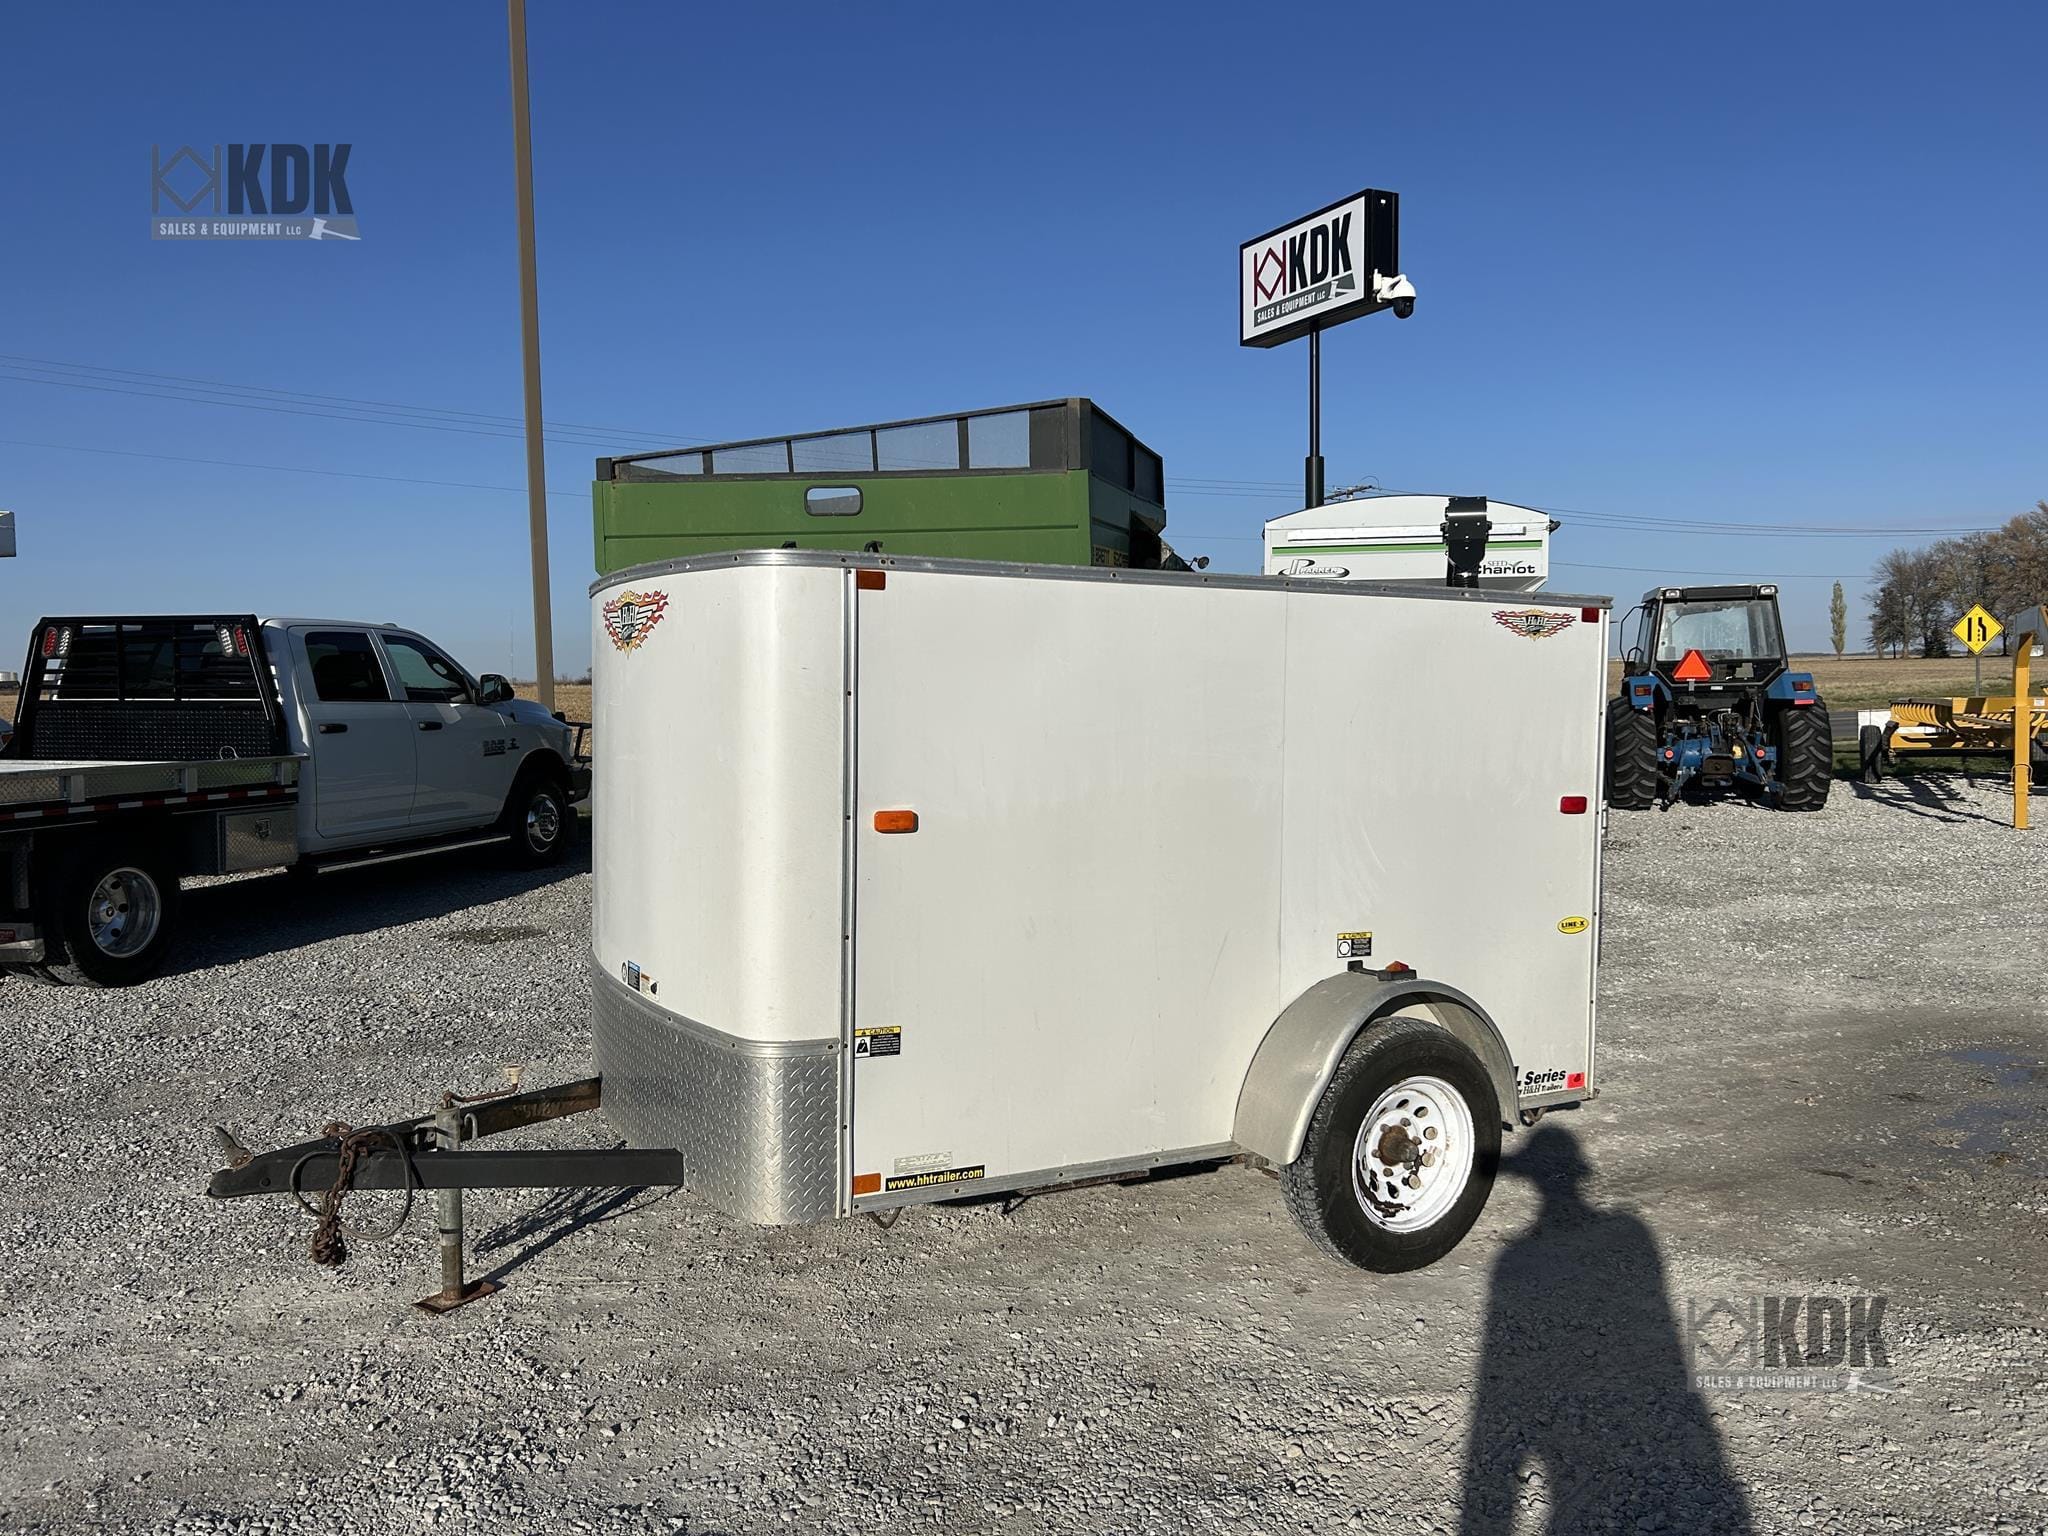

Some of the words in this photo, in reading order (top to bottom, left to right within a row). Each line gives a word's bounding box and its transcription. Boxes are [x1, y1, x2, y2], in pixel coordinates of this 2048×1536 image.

[1289, 211, 1353, 294] KDK
[1257, 307, 1275, 323] SALES
[1276, 305, 1280, 316] &
[1281, 292, 1316, 314] EQUIPMENT
[1317, 290, 1326, 301] LLC
[1524, 1068, 1567, 1086] Series
[887, 1168, 983, 1190] www.hhtrailer.com
